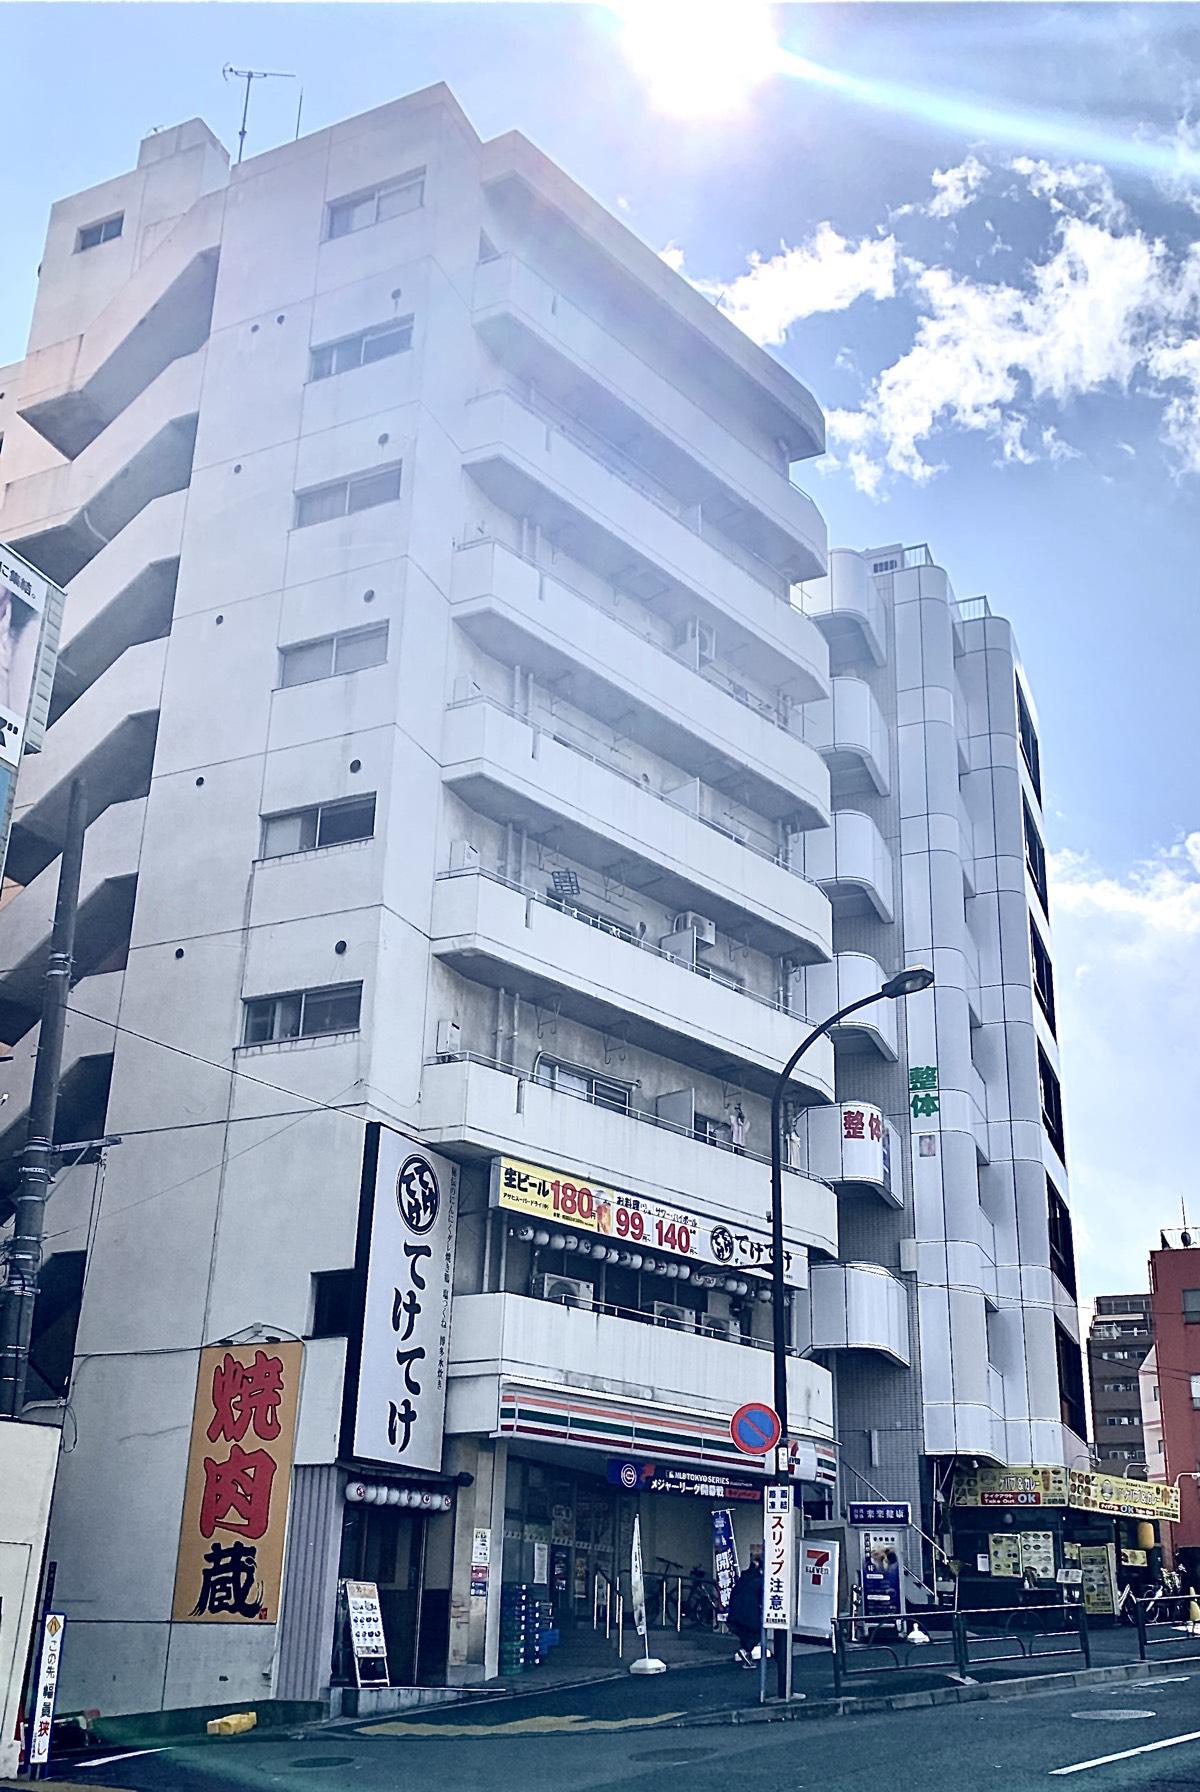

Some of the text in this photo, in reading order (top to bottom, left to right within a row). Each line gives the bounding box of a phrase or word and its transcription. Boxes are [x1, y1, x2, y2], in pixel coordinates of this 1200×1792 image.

[503, 1167, 550, 1198] 生ビール
[389, 1239, 432, 1453] てけてけ
[708, 1475, 730, 1485] SERIES
[1017, 1493, 1037, 1504] OK
[1120, 1504, 1135, 1514] OK
[769, 1516, 785, 1611] スリップ注意
